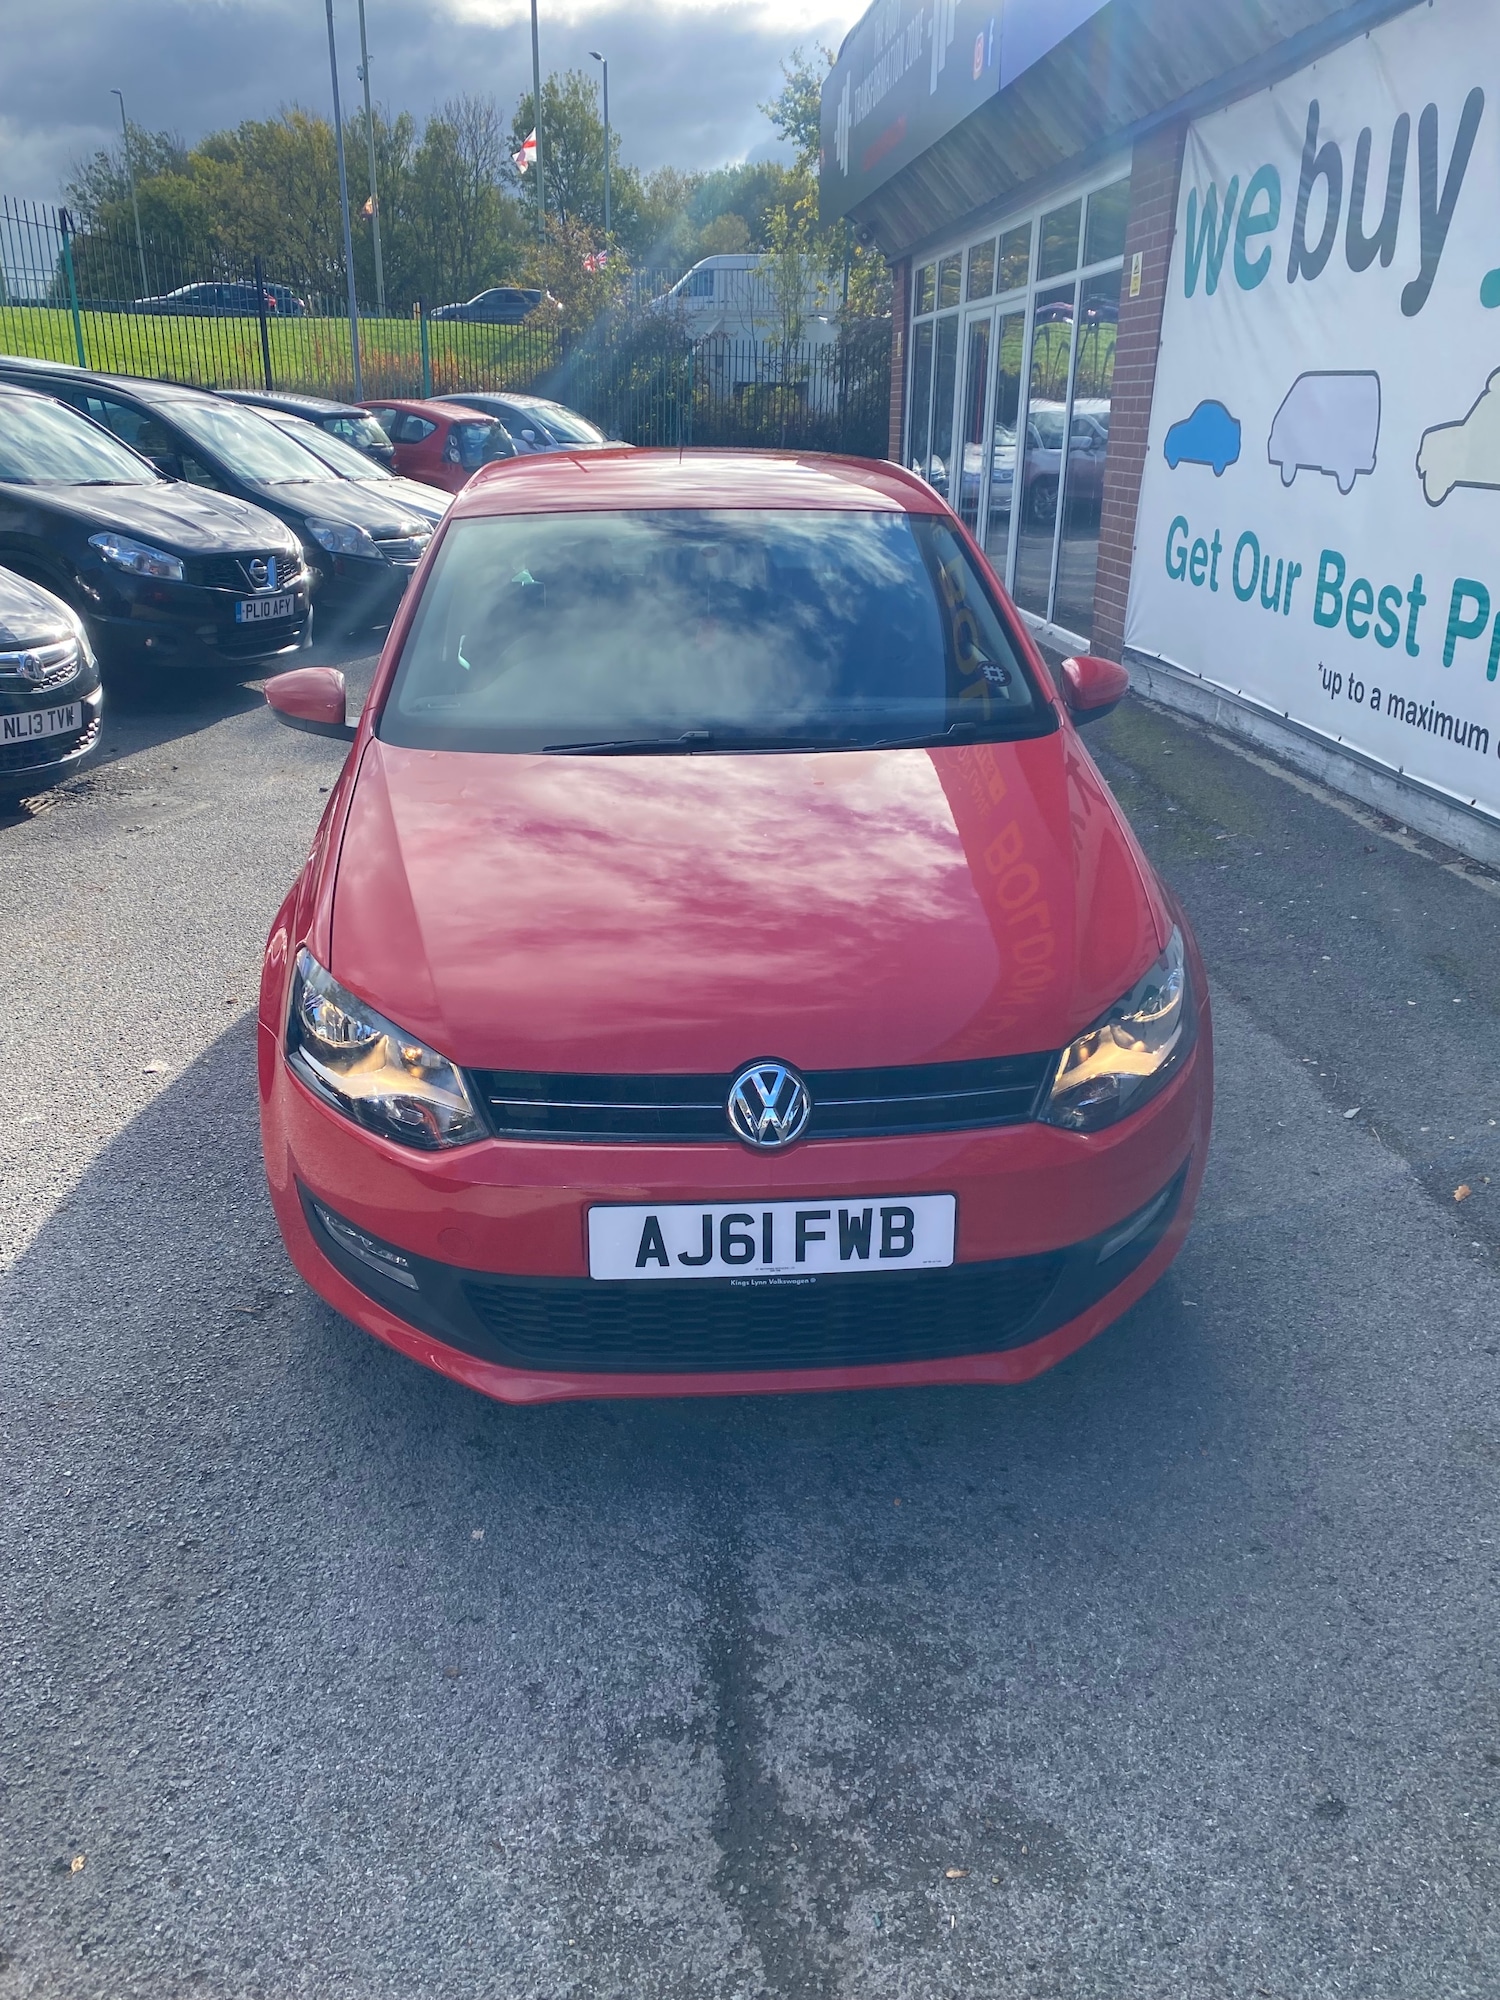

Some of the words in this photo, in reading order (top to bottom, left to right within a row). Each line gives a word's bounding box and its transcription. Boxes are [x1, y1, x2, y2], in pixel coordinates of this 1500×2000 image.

[905, 7, 924, 71] ZONE
[246, 601, 270, 619] PL10
[273, 598, 291, 616] AFY
[1165, 515, 1223, 592] Get
[1232, 530, 1302, 616] Our
[1313, 549, 1427, 657] Best
[3, 714, 43, 739] NL13
[47, 706, 74, 731] TVW
[1348, 672, 1365, 703] to
[1370, 687, 1382, 711] a
[1387, 693, 1490, 754] maximum
[635, 1212, 773, 1267] AJ61
[795, 1206, 915, 1262] FWB
[730, 1279, 750, 1287] Kings
[769, 1277, 809, 1286] Volkswagen
